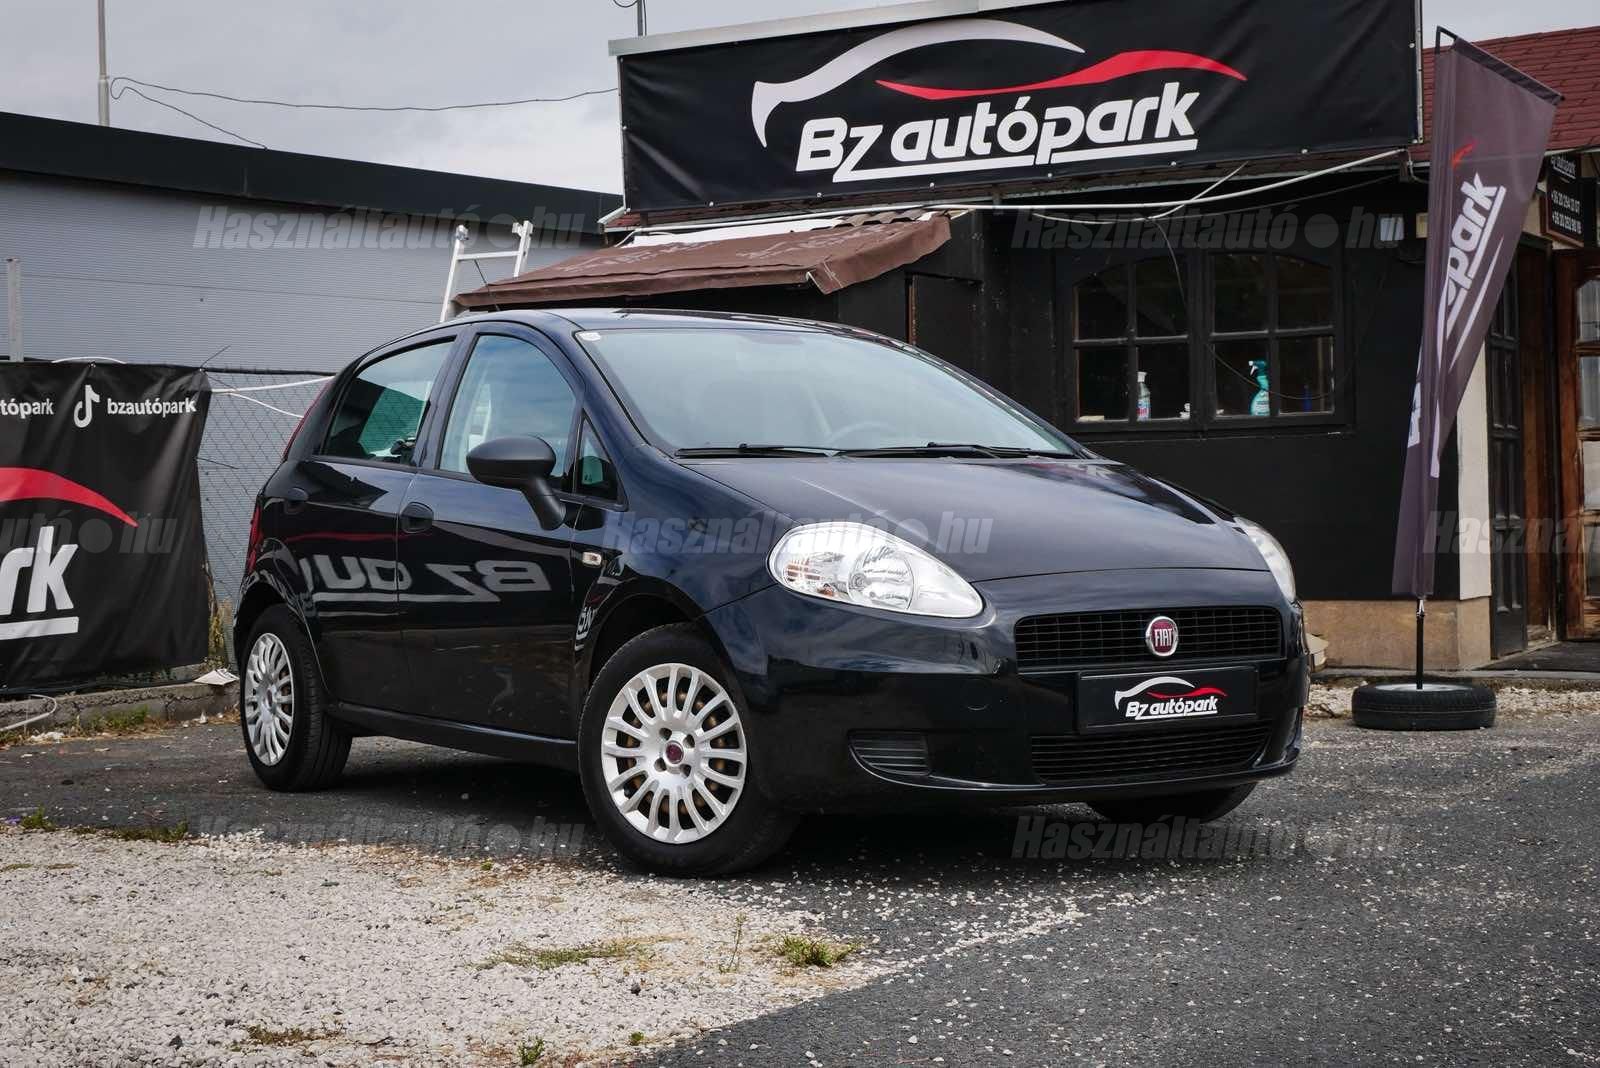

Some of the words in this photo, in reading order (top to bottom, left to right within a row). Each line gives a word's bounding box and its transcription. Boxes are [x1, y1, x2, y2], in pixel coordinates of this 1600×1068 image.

[796, 116, 883, 183] Bz
[891, 82, 1199, 165] autópark
[107, 397, 197, 418] bzautópark
[1154, 628, 1174, 647] FIAT
[1125, 700, 1150, 720] Bz
[1150, 695, 1218, 716] autópark
